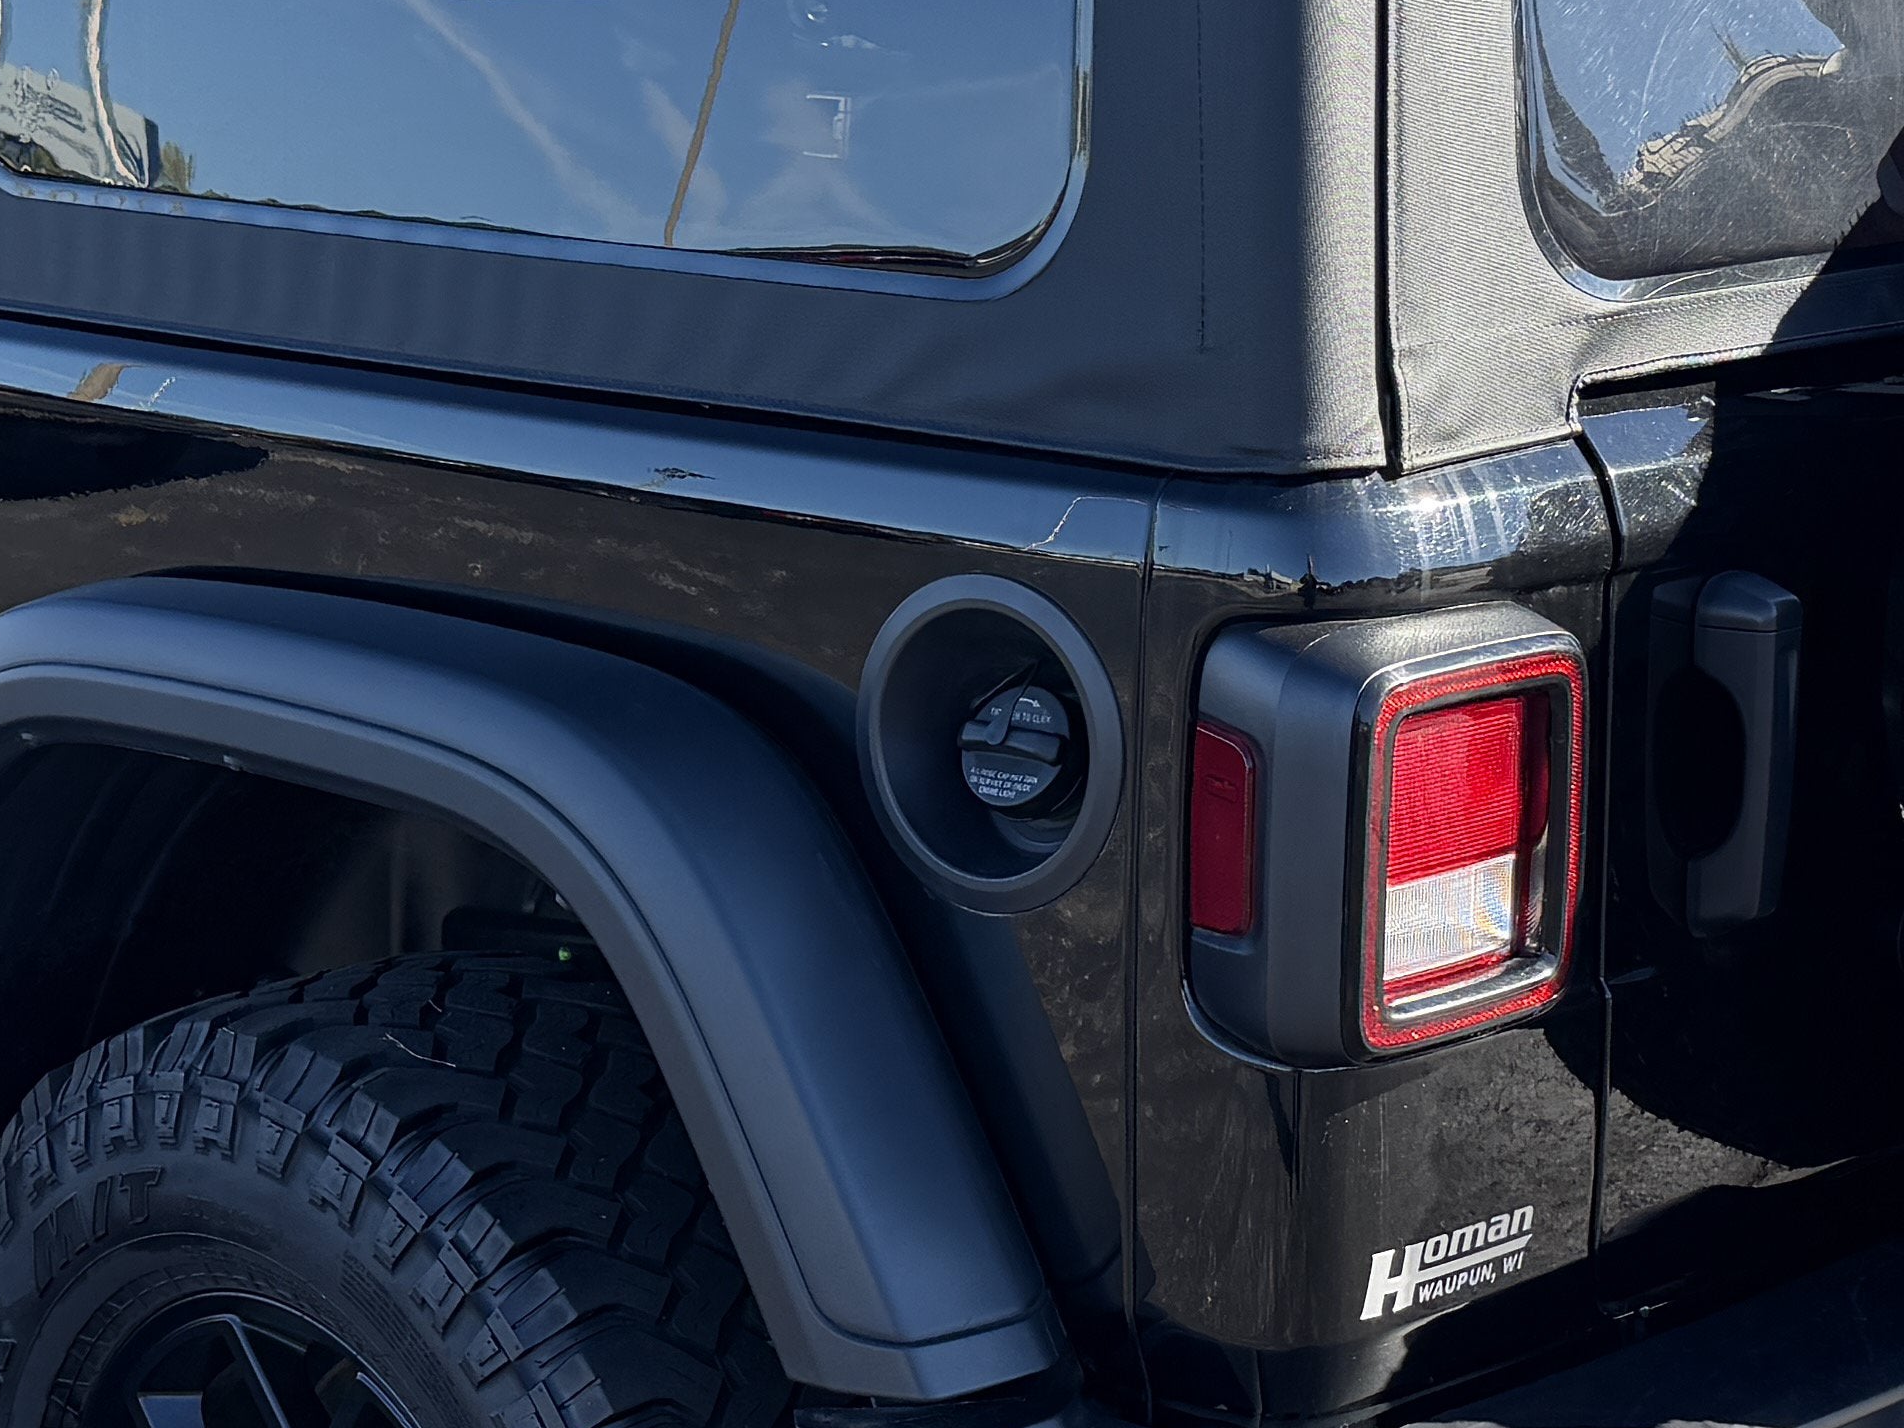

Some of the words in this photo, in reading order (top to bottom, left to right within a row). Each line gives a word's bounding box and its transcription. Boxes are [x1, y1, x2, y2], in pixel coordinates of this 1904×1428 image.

[32, 1164, 167, 1299] M/T
[1359, 1204, 1534, 1321] Homan
[1418, 1261, 1497, 1304] WAUPUN,
[1503, 1250, 1525, 1275] WI
